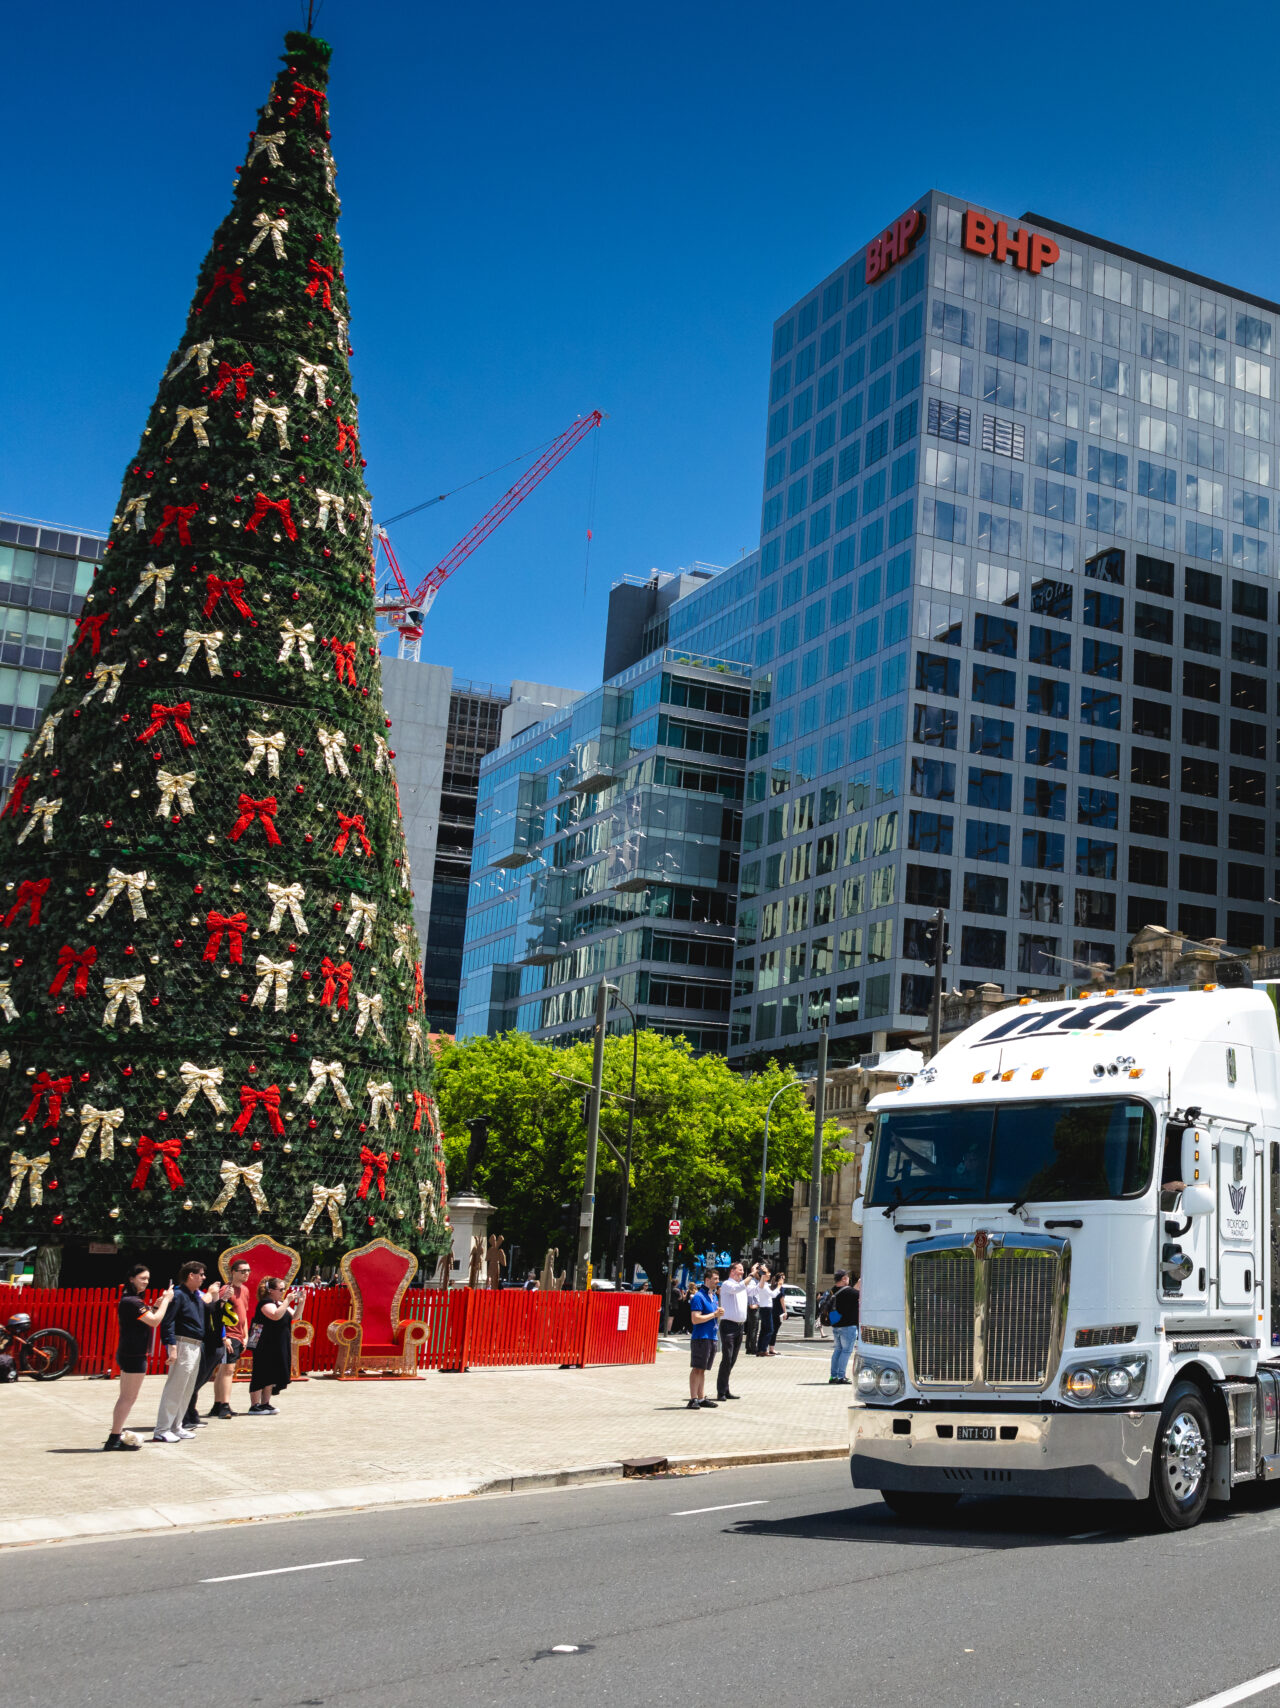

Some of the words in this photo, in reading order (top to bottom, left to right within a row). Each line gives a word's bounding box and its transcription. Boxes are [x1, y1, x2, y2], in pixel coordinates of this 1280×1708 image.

[865, 209, 920, 284] BHP
[965, 209, 1061, 275] BHP
[978, 998, 1176, 1043] nti
